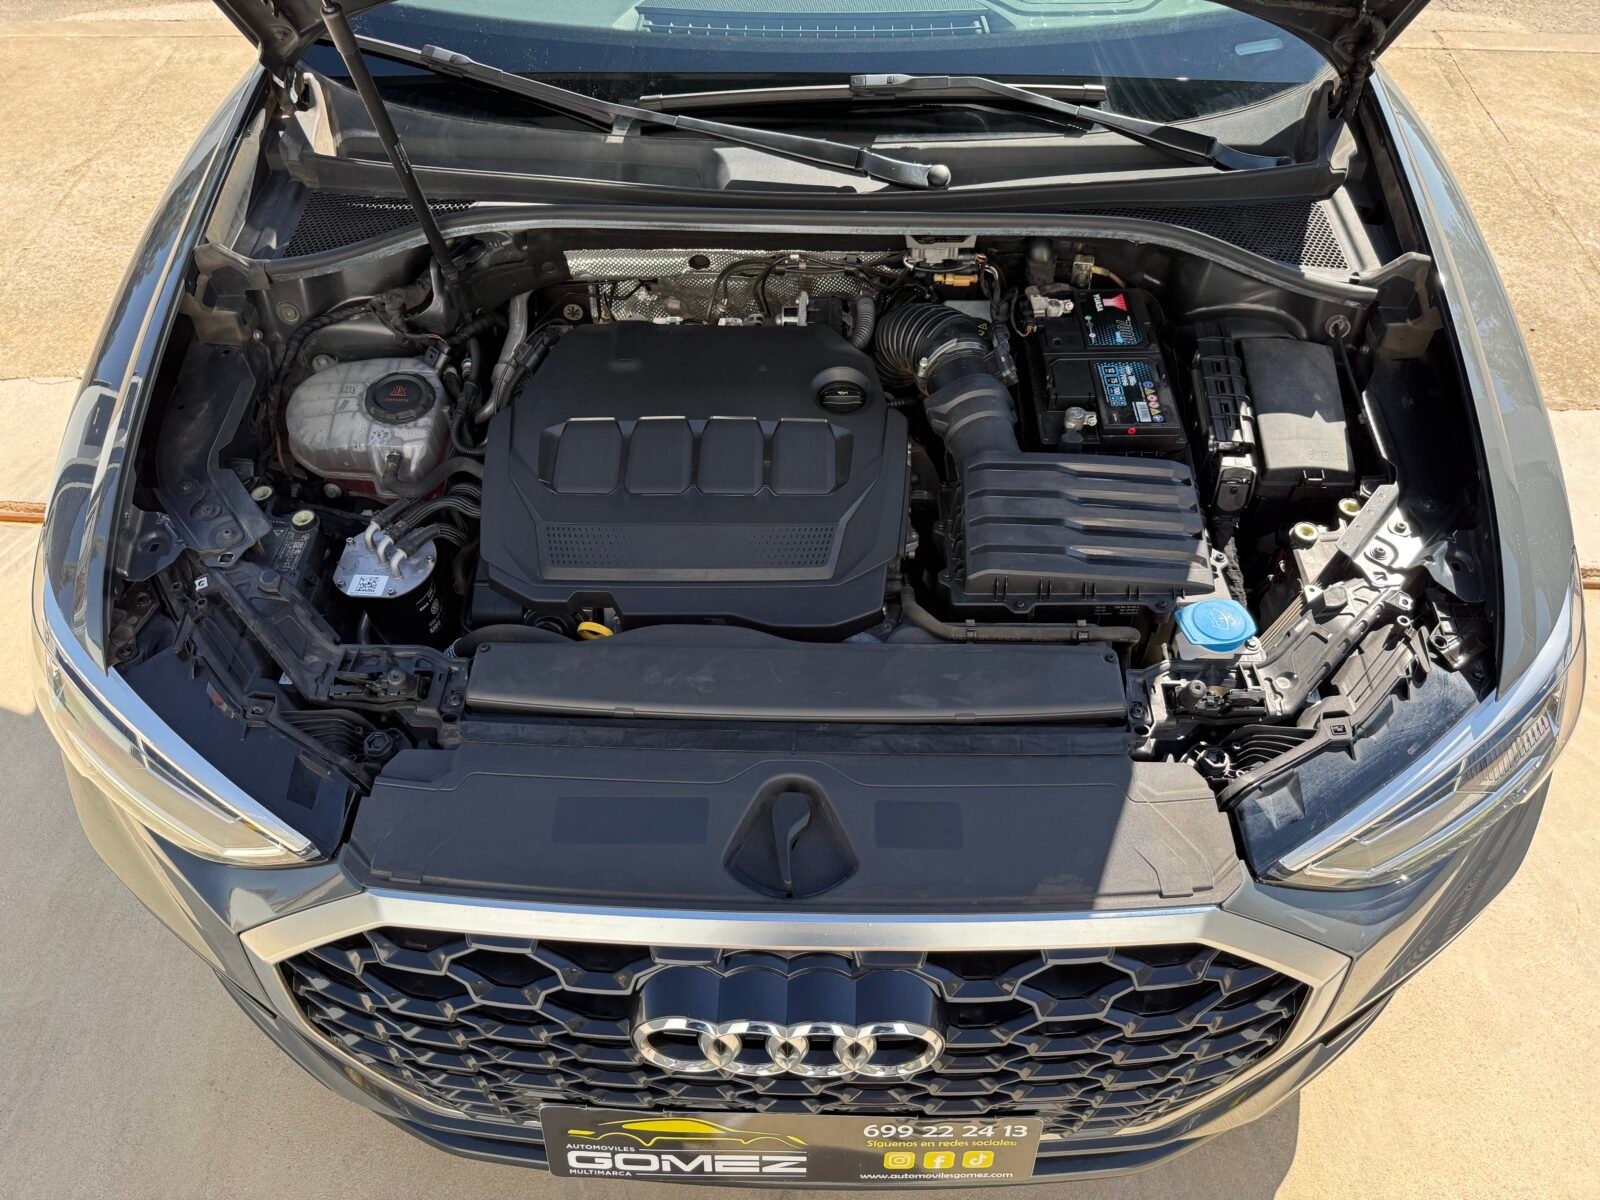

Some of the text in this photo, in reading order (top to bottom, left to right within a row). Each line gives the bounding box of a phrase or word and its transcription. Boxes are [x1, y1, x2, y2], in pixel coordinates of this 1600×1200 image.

[1093, 293, 1104, 312] YUASA
[863, 1124, 1028, 1138] 699 22 24 13
[566, 1143, 636, 1152] AUTOMOVILES
[938, 1139, 969, 1147] redes
[972, 1139, 1017, 1147] sociales:
[567, 1151, 807, 1173] GOMEZ
[569, 1168, 632, 1176] MULTIMARCA
